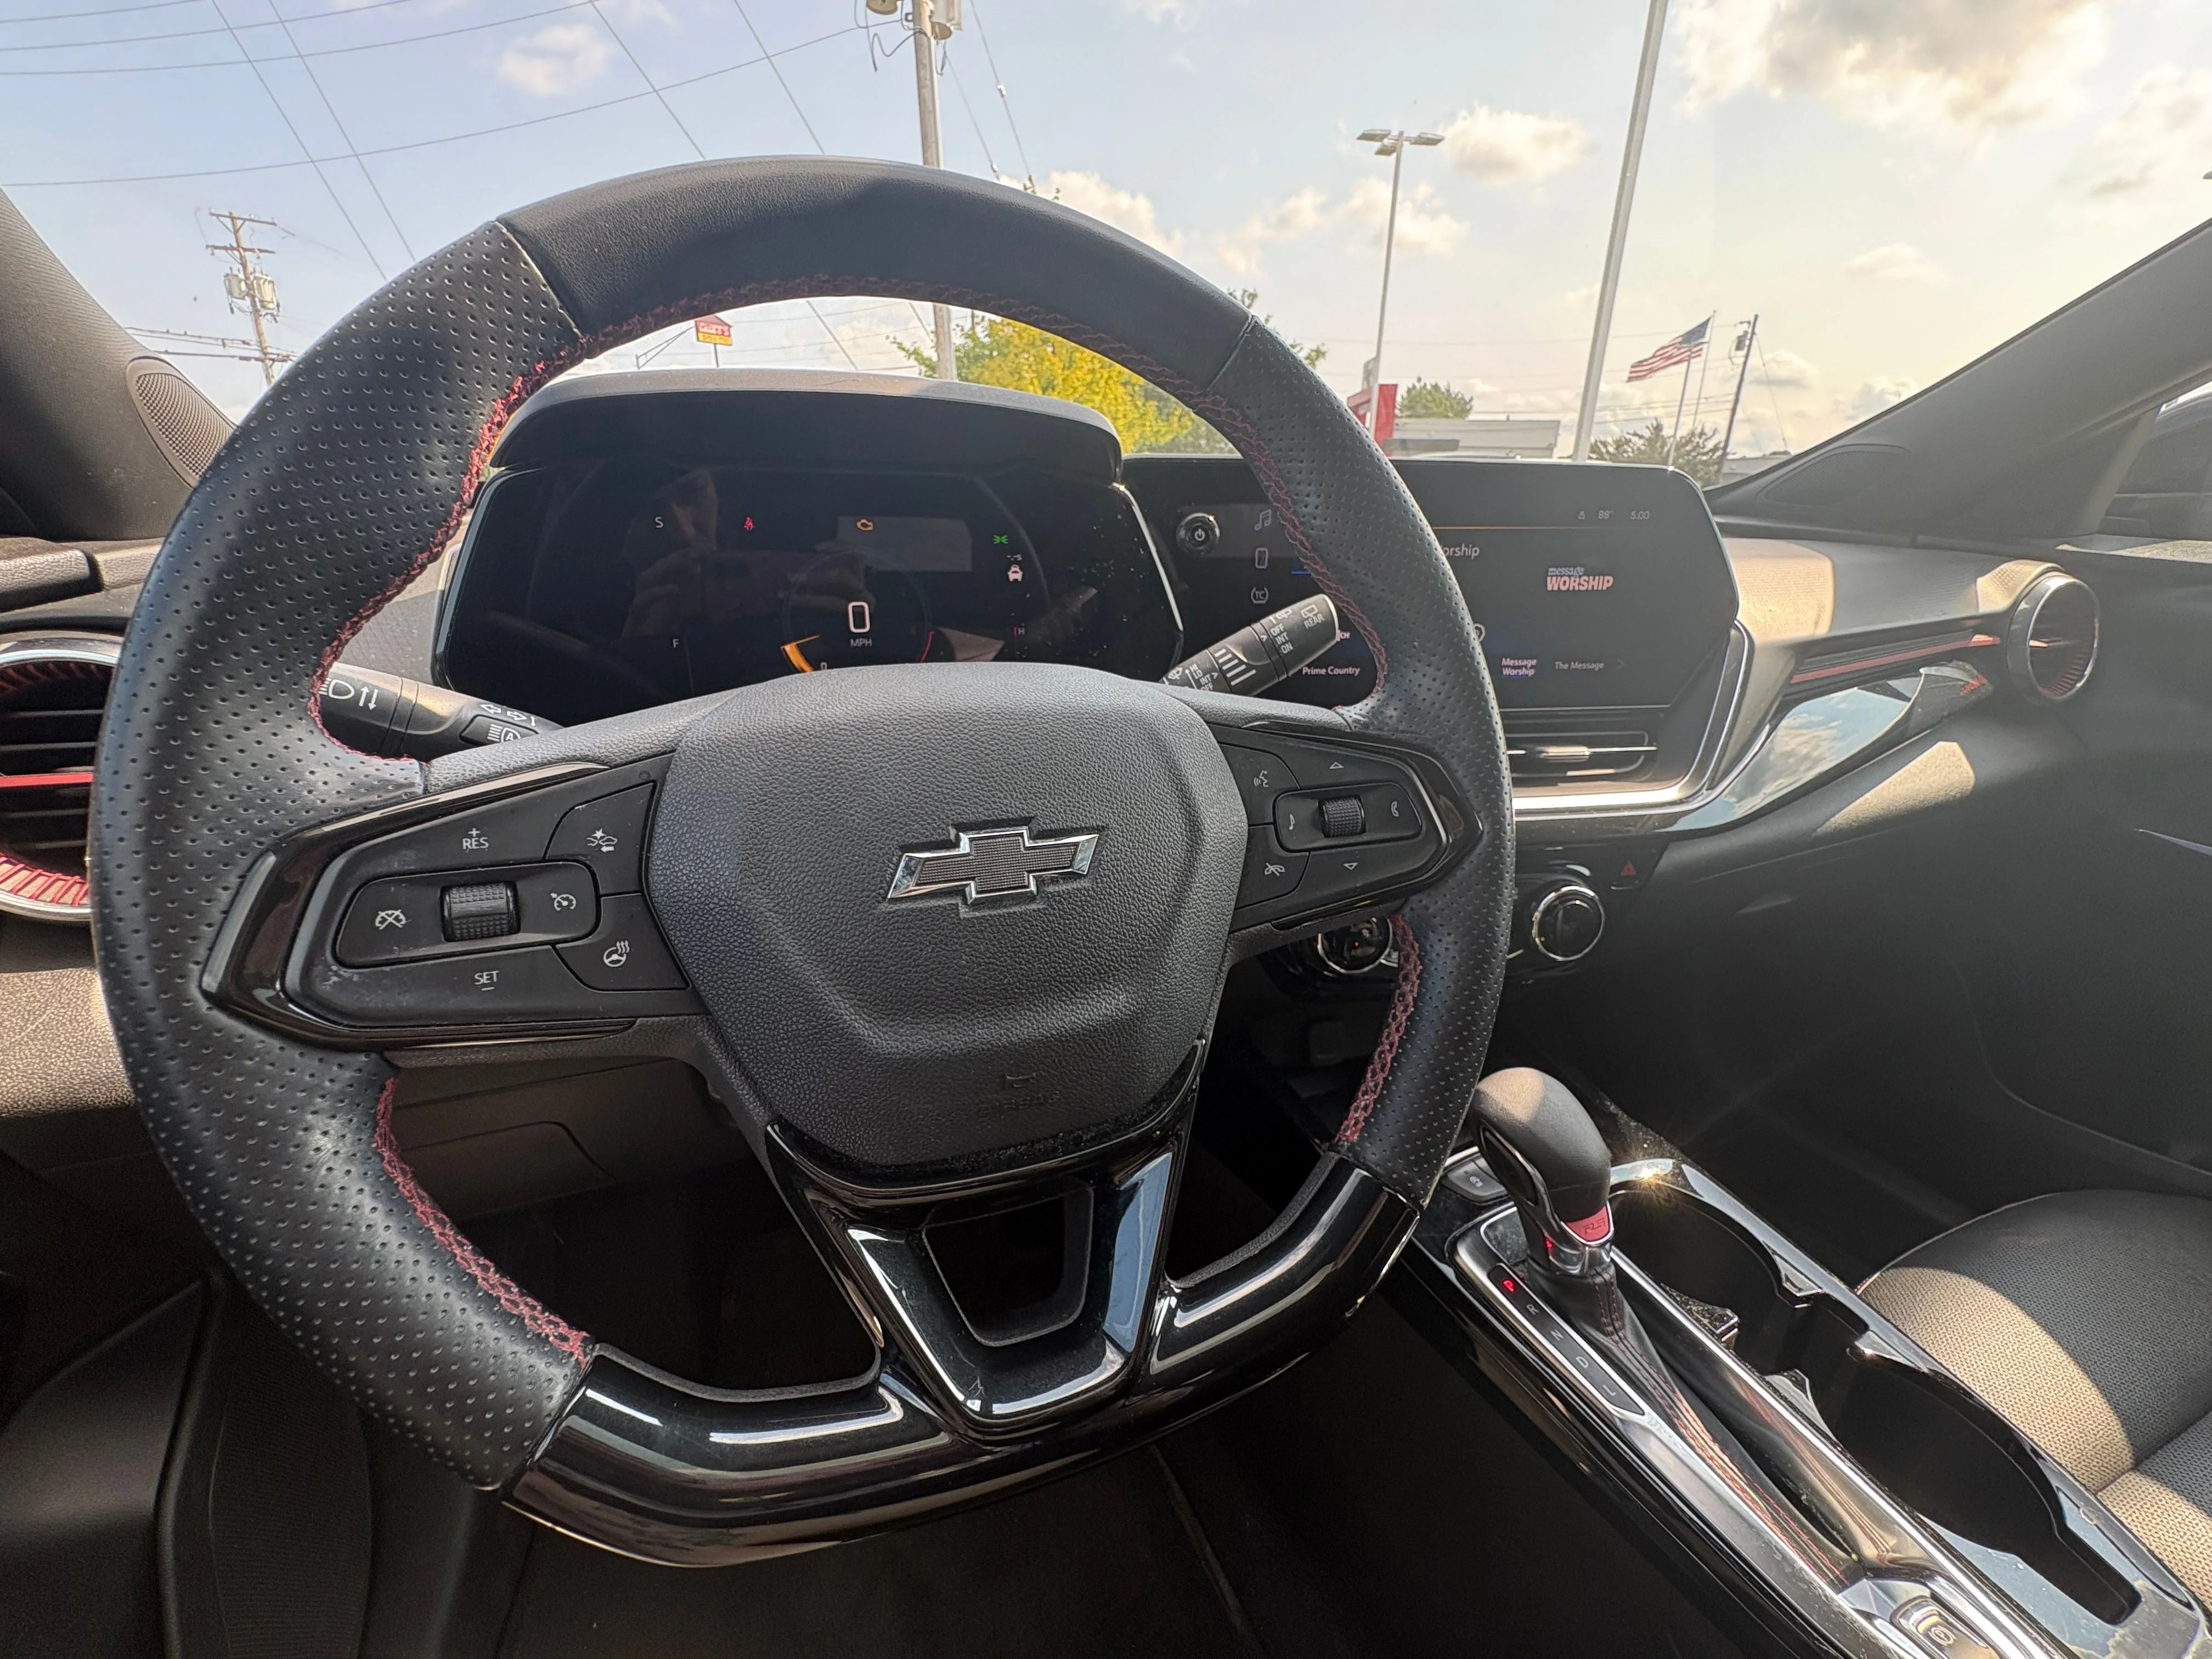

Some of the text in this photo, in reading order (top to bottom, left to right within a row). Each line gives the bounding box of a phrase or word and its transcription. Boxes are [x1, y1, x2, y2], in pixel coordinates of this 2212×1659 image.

[1630, 511, 1650, 520] 5:00
[655, 516, 664, 528] S
[1440, 543, 1480, 560] orship
[1547, 575, 1613, 591] WORSHIP
[848, 601, 870, 633] 0
[1304, 613, 1325, 629] REAR
[1270, 623, 1284, 636] OFF
[673, 639, 679, 648] F
[850, 638, 872, 647] MPH
[1275, 632, 1289, 645] INT
[1280, 642, 1294, 654] ON
[1189, 663, 1198, 673] HI
[1502, 658, 1537, 667] Message
[1555, 661, 1604, 671] The Message
[1193, 669, 1203, 680] LO
[1302, 665, 1361, 676] Prime Country
[1502, 667, 1535, 677] Worship
[1199, 674, 1211, 685] INT
[462, 837, 489, 850] RES
[474, 970, 500, 985] SET
[1502, 1279, 1514, 1293] P
[1526, 1304, 1539, 1316] R
[1550, 1329, 1564, 1341] N
[1576, 1356, 1589, 1369] D
[1602, 1385, 1616, 1396] L
